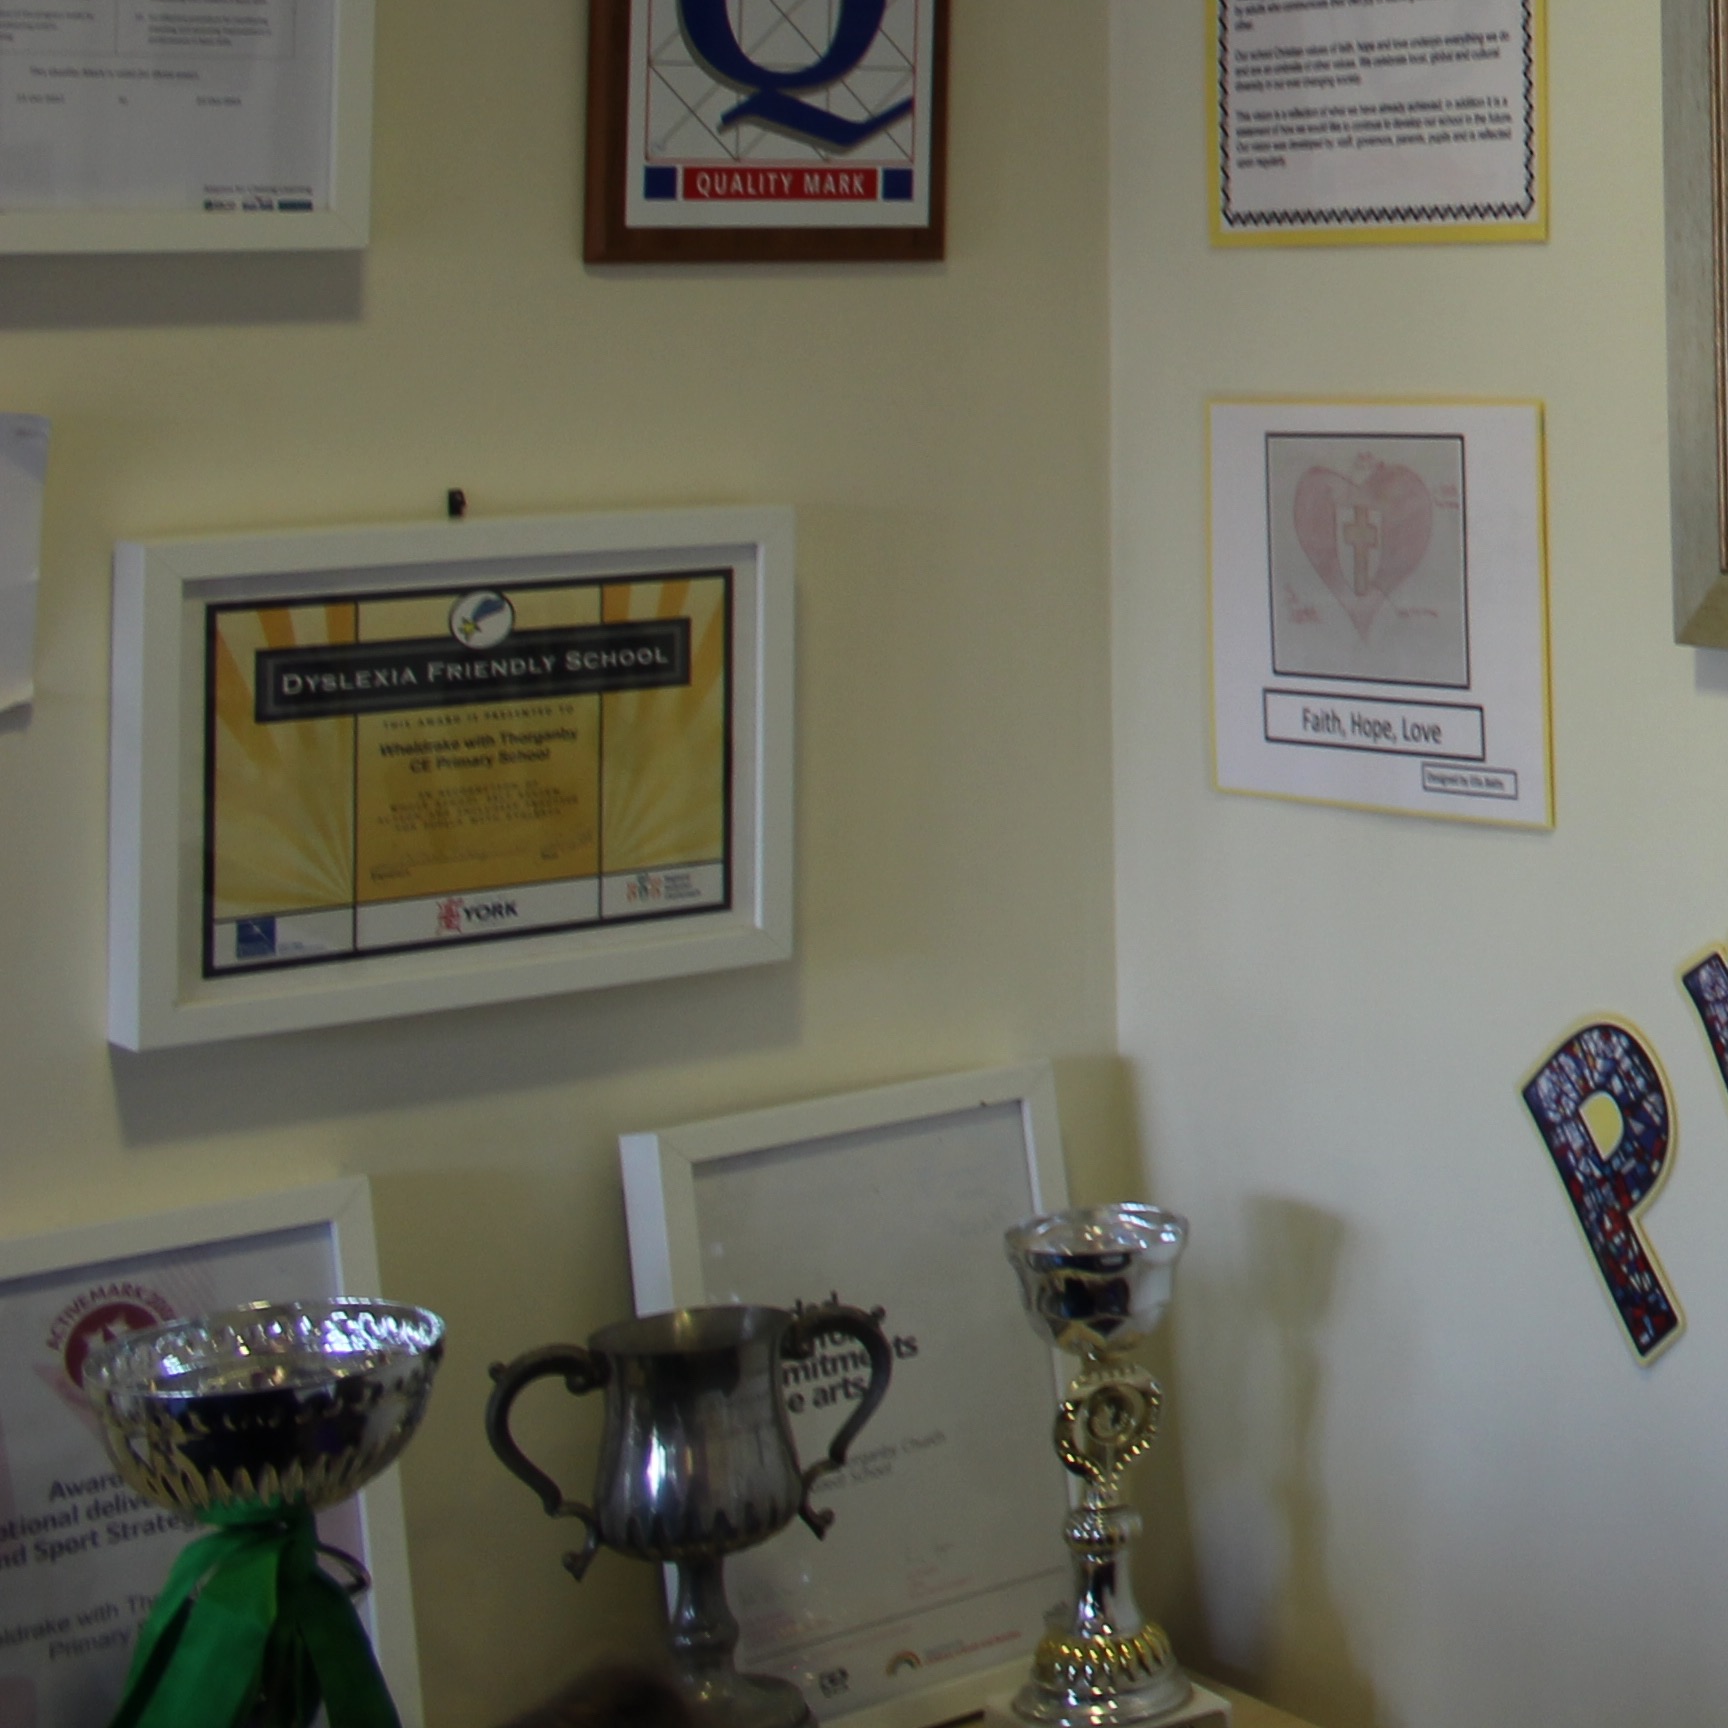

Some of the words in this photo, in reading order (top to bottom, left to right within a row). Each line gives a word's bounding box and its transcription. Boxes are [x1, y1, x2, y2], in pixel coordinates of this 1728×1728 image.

[695, 171, 793, 198] QUALITY
[803, 169, 866, 196] MARK
[281, 666, 418, 696] DYSLEXIA
[426, 654, 556, 683] FRIENDLY
[564, 646, 670, 672] SCHOOL
[1302, 706, 1346, 738] Faith,
[1350, 712, 1398, 745] Hope,
[1401, 716, 1442, 745] Love
[462, 900, 519, 922] YORK
[33, 1528, 99, 1564] Sport
[76, 1601, 120, 1626] with
[48, 1627, 131, 1662] Primary
